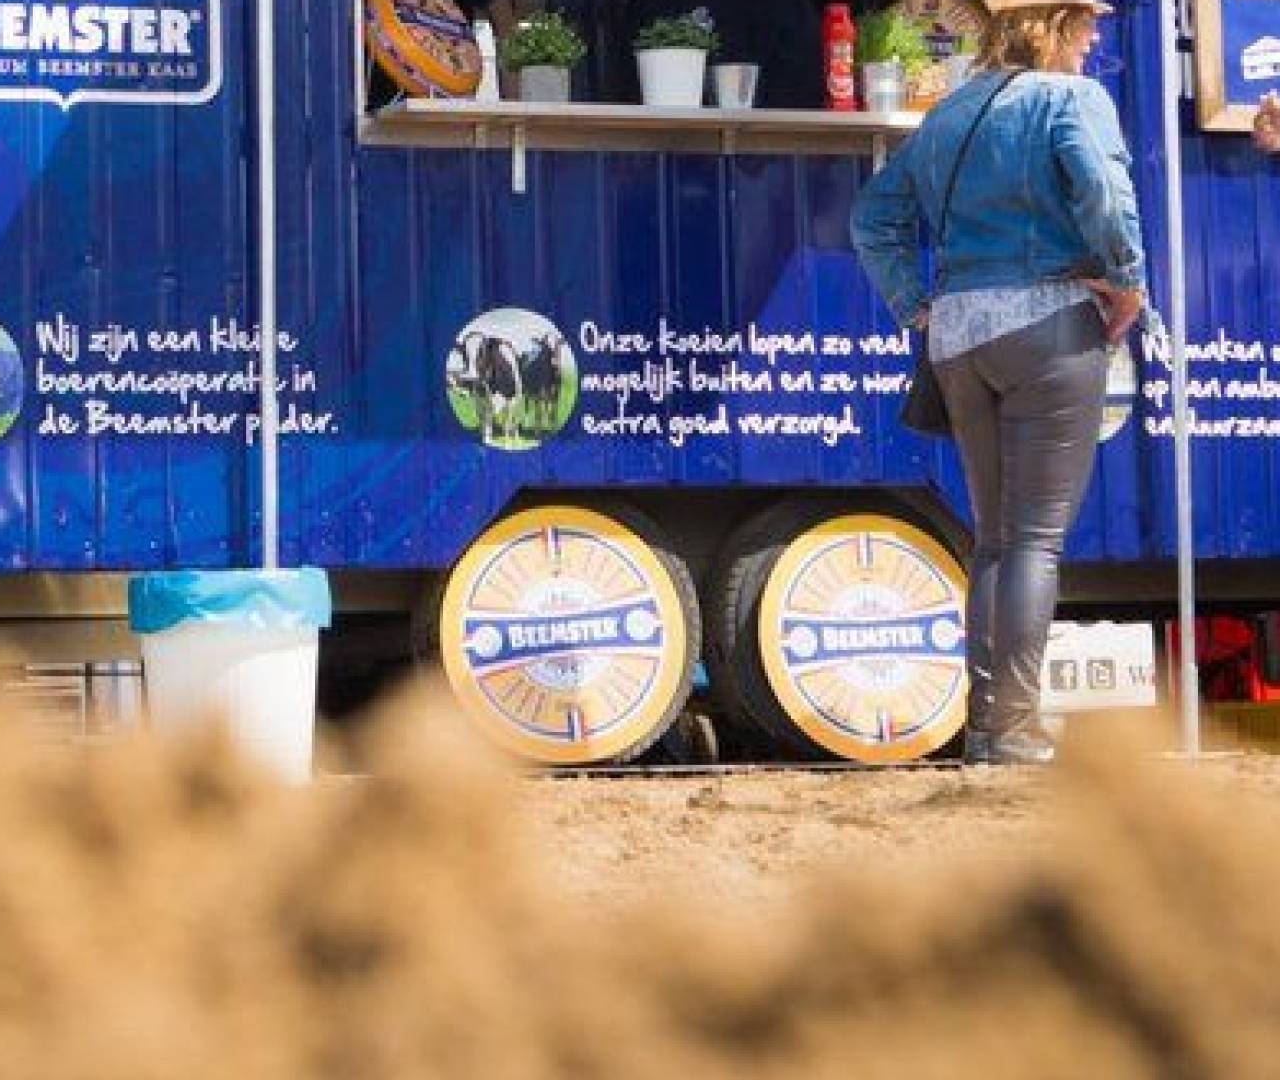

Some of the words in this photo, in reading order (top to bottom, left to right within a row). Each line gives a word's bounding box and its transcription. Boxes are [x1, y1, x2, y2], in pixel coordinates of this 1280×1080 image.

[36, 311, 78, 362] Wij
[89, 322, 138, 361] zijn
[150, 330, 200, 352] een
[210, 315, 298, 355] kleie
[579, 320, 652, 354] Onze
[658, 318, 743, 354] koeien
[748, 322, 815, 364] lopen
[820, 334, 852, 355] zo
[859, 327, 910, 355] veel
[292, 363, 317, 392] in
[581, 358, 683, 402] mogelijk
[689, 361, 772, 393] buiten
[781, 369, 814, 392] en
[819, 369, 857, 393] ze
[39, 404, 79, 434] de
[85, 399, 237, 434] Beemster
[245, 401, 339, 447] pder.
[581, 400, 663, 436] extra
[669, 403, 727, 447] goed
[738, 404, 860, 447] verzorgd.
[507, 616, 620, 648] BEEMSTER
[822, 626, 924, 650] BEEMSTER
